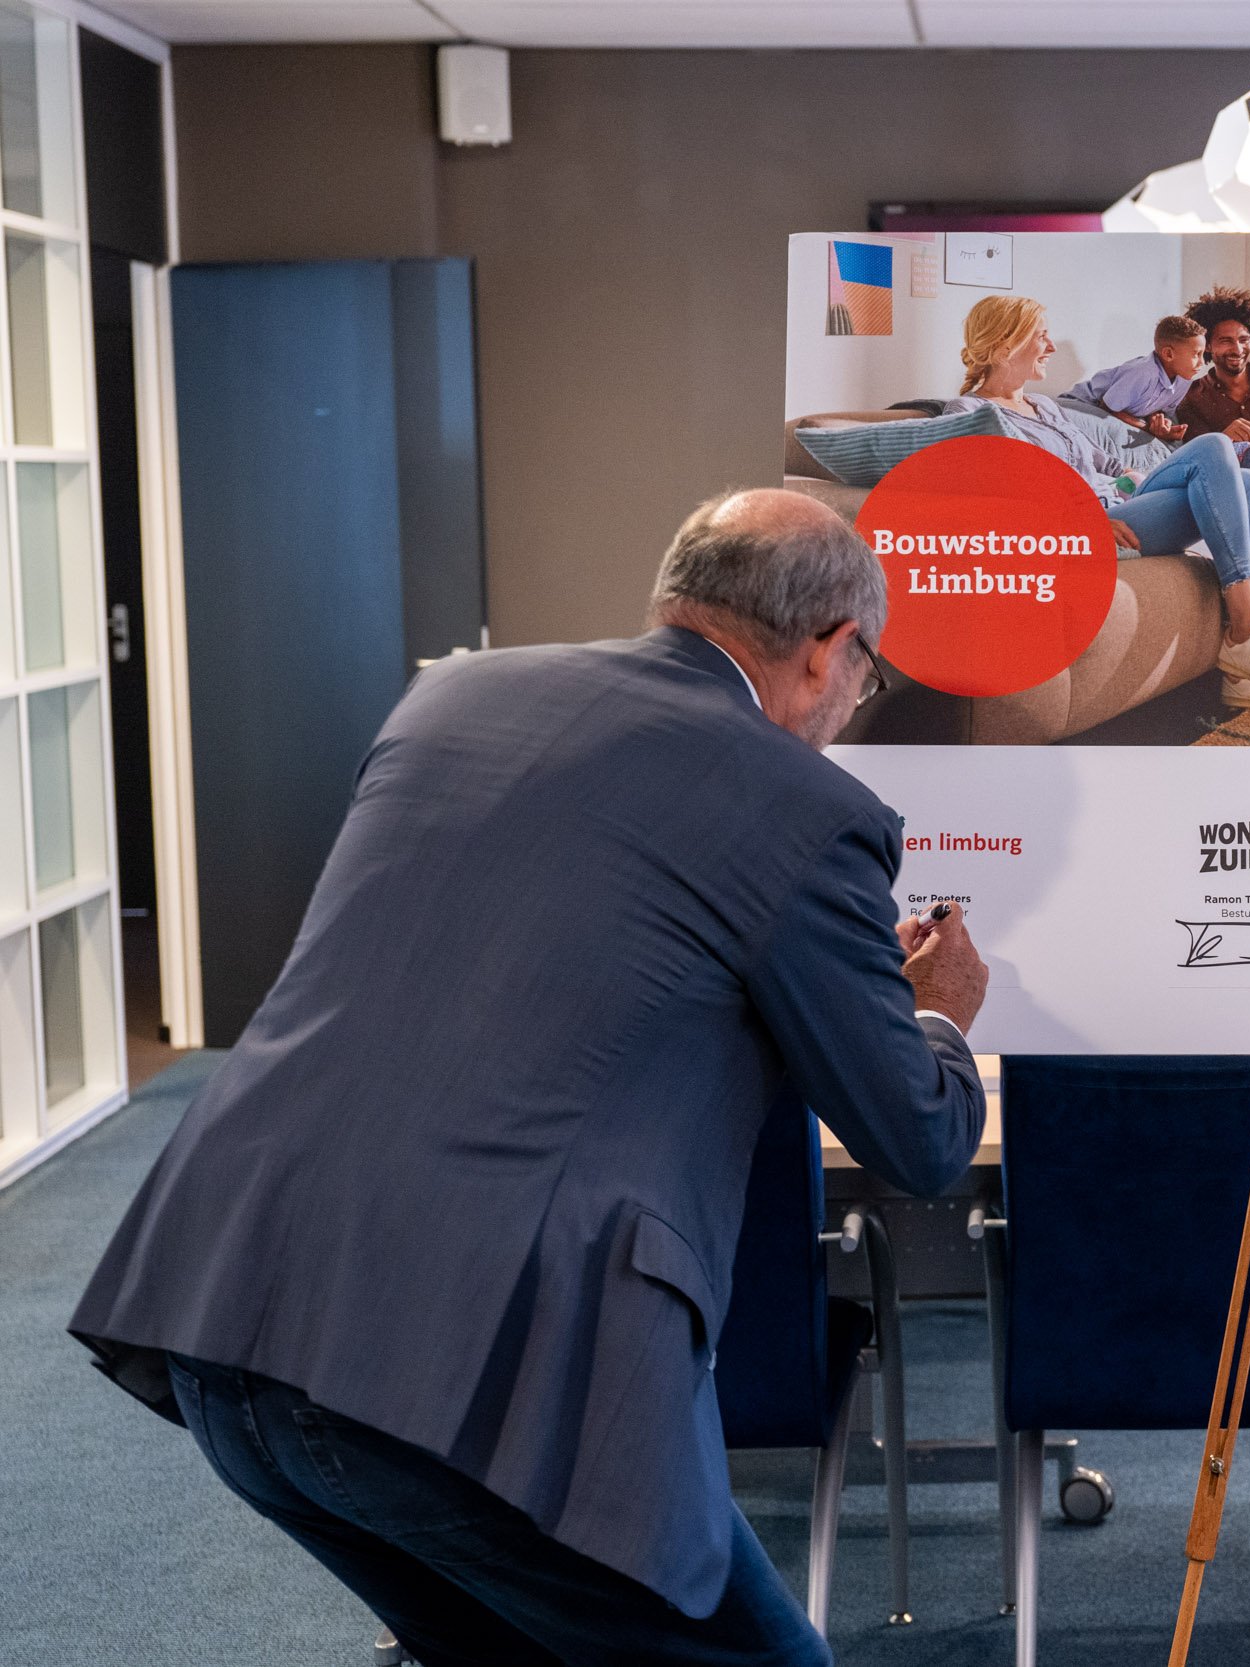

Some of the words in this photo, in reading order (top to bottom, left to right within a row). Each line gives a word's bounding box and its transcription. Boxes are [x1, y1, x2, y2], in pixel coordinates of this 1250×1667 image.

[873, 529, 1092, 555] Bouwstroom
[908, 566, 1056, 602] Limburg
[939, 833, 1022, 855] limburg
[908, 894, 927, 903] Ger
[930, 894, 971, 903] Peeters
[1204, 895, 1242, 904] Ramon
